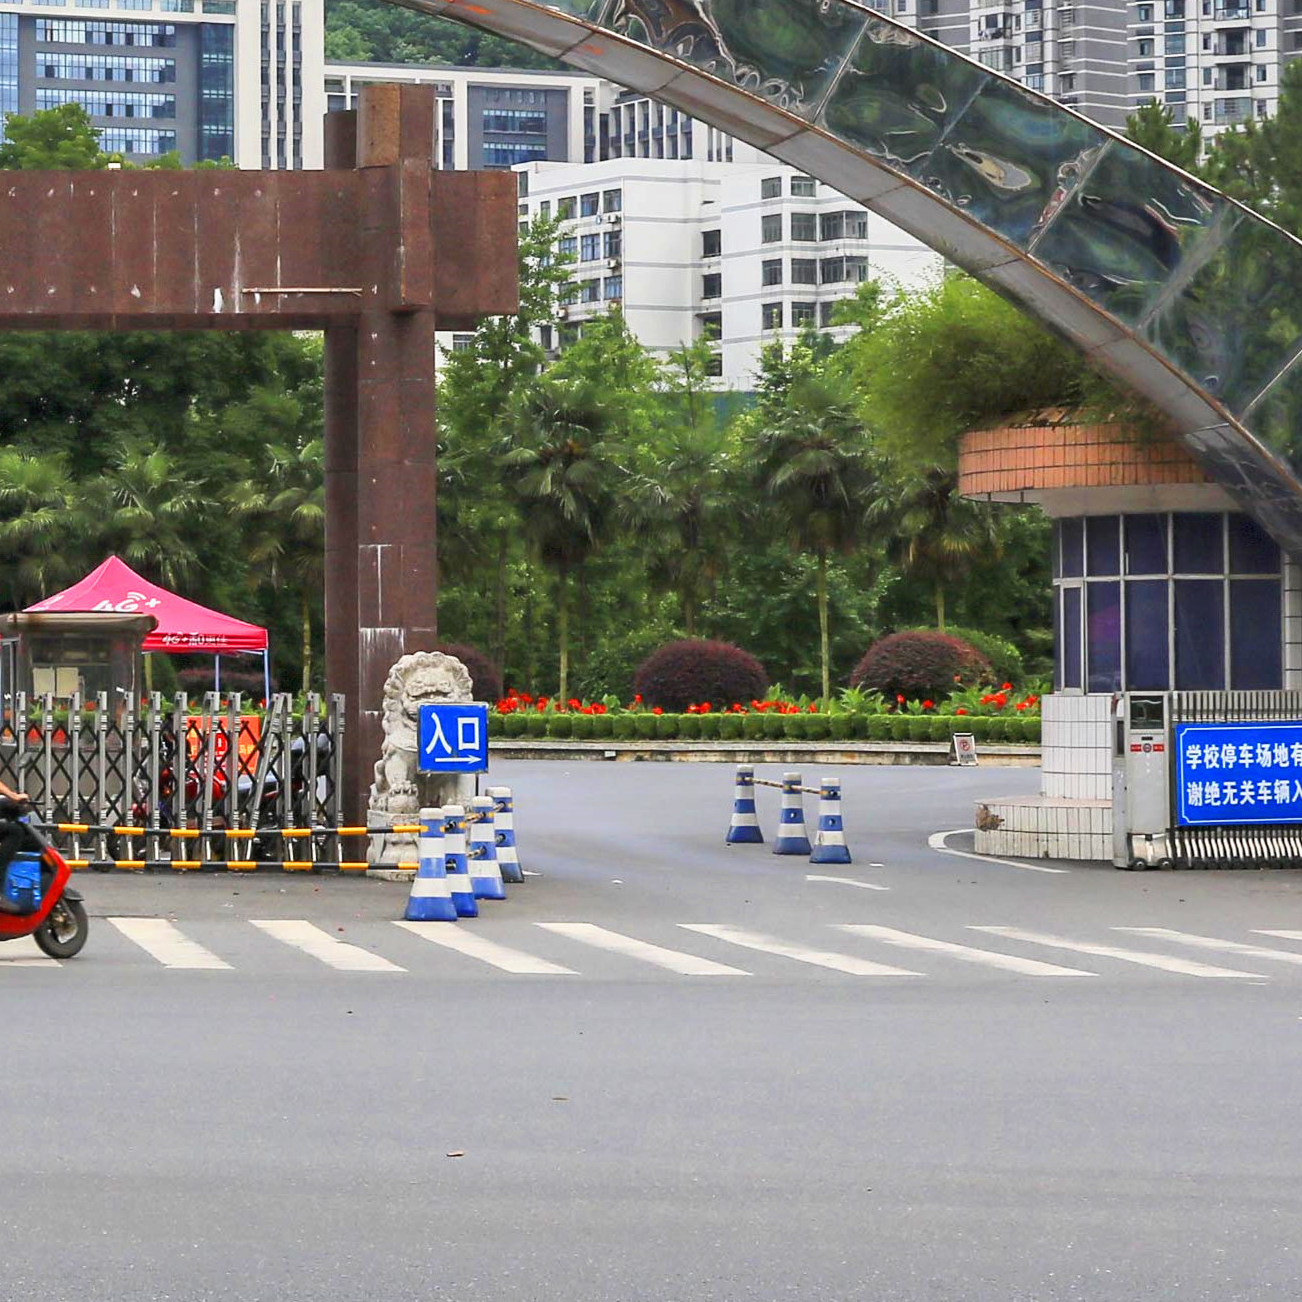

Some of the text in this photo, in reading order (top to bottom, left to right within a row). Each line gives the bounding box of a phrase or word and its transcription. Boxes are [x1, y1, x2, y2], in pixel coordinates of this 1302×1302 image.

[425, 712, 481, 755] 入口
[1186, 742, 1302, 770] 学校停车场地有
[1186, 779, 1302, 807] 谢绝无关车辆入
